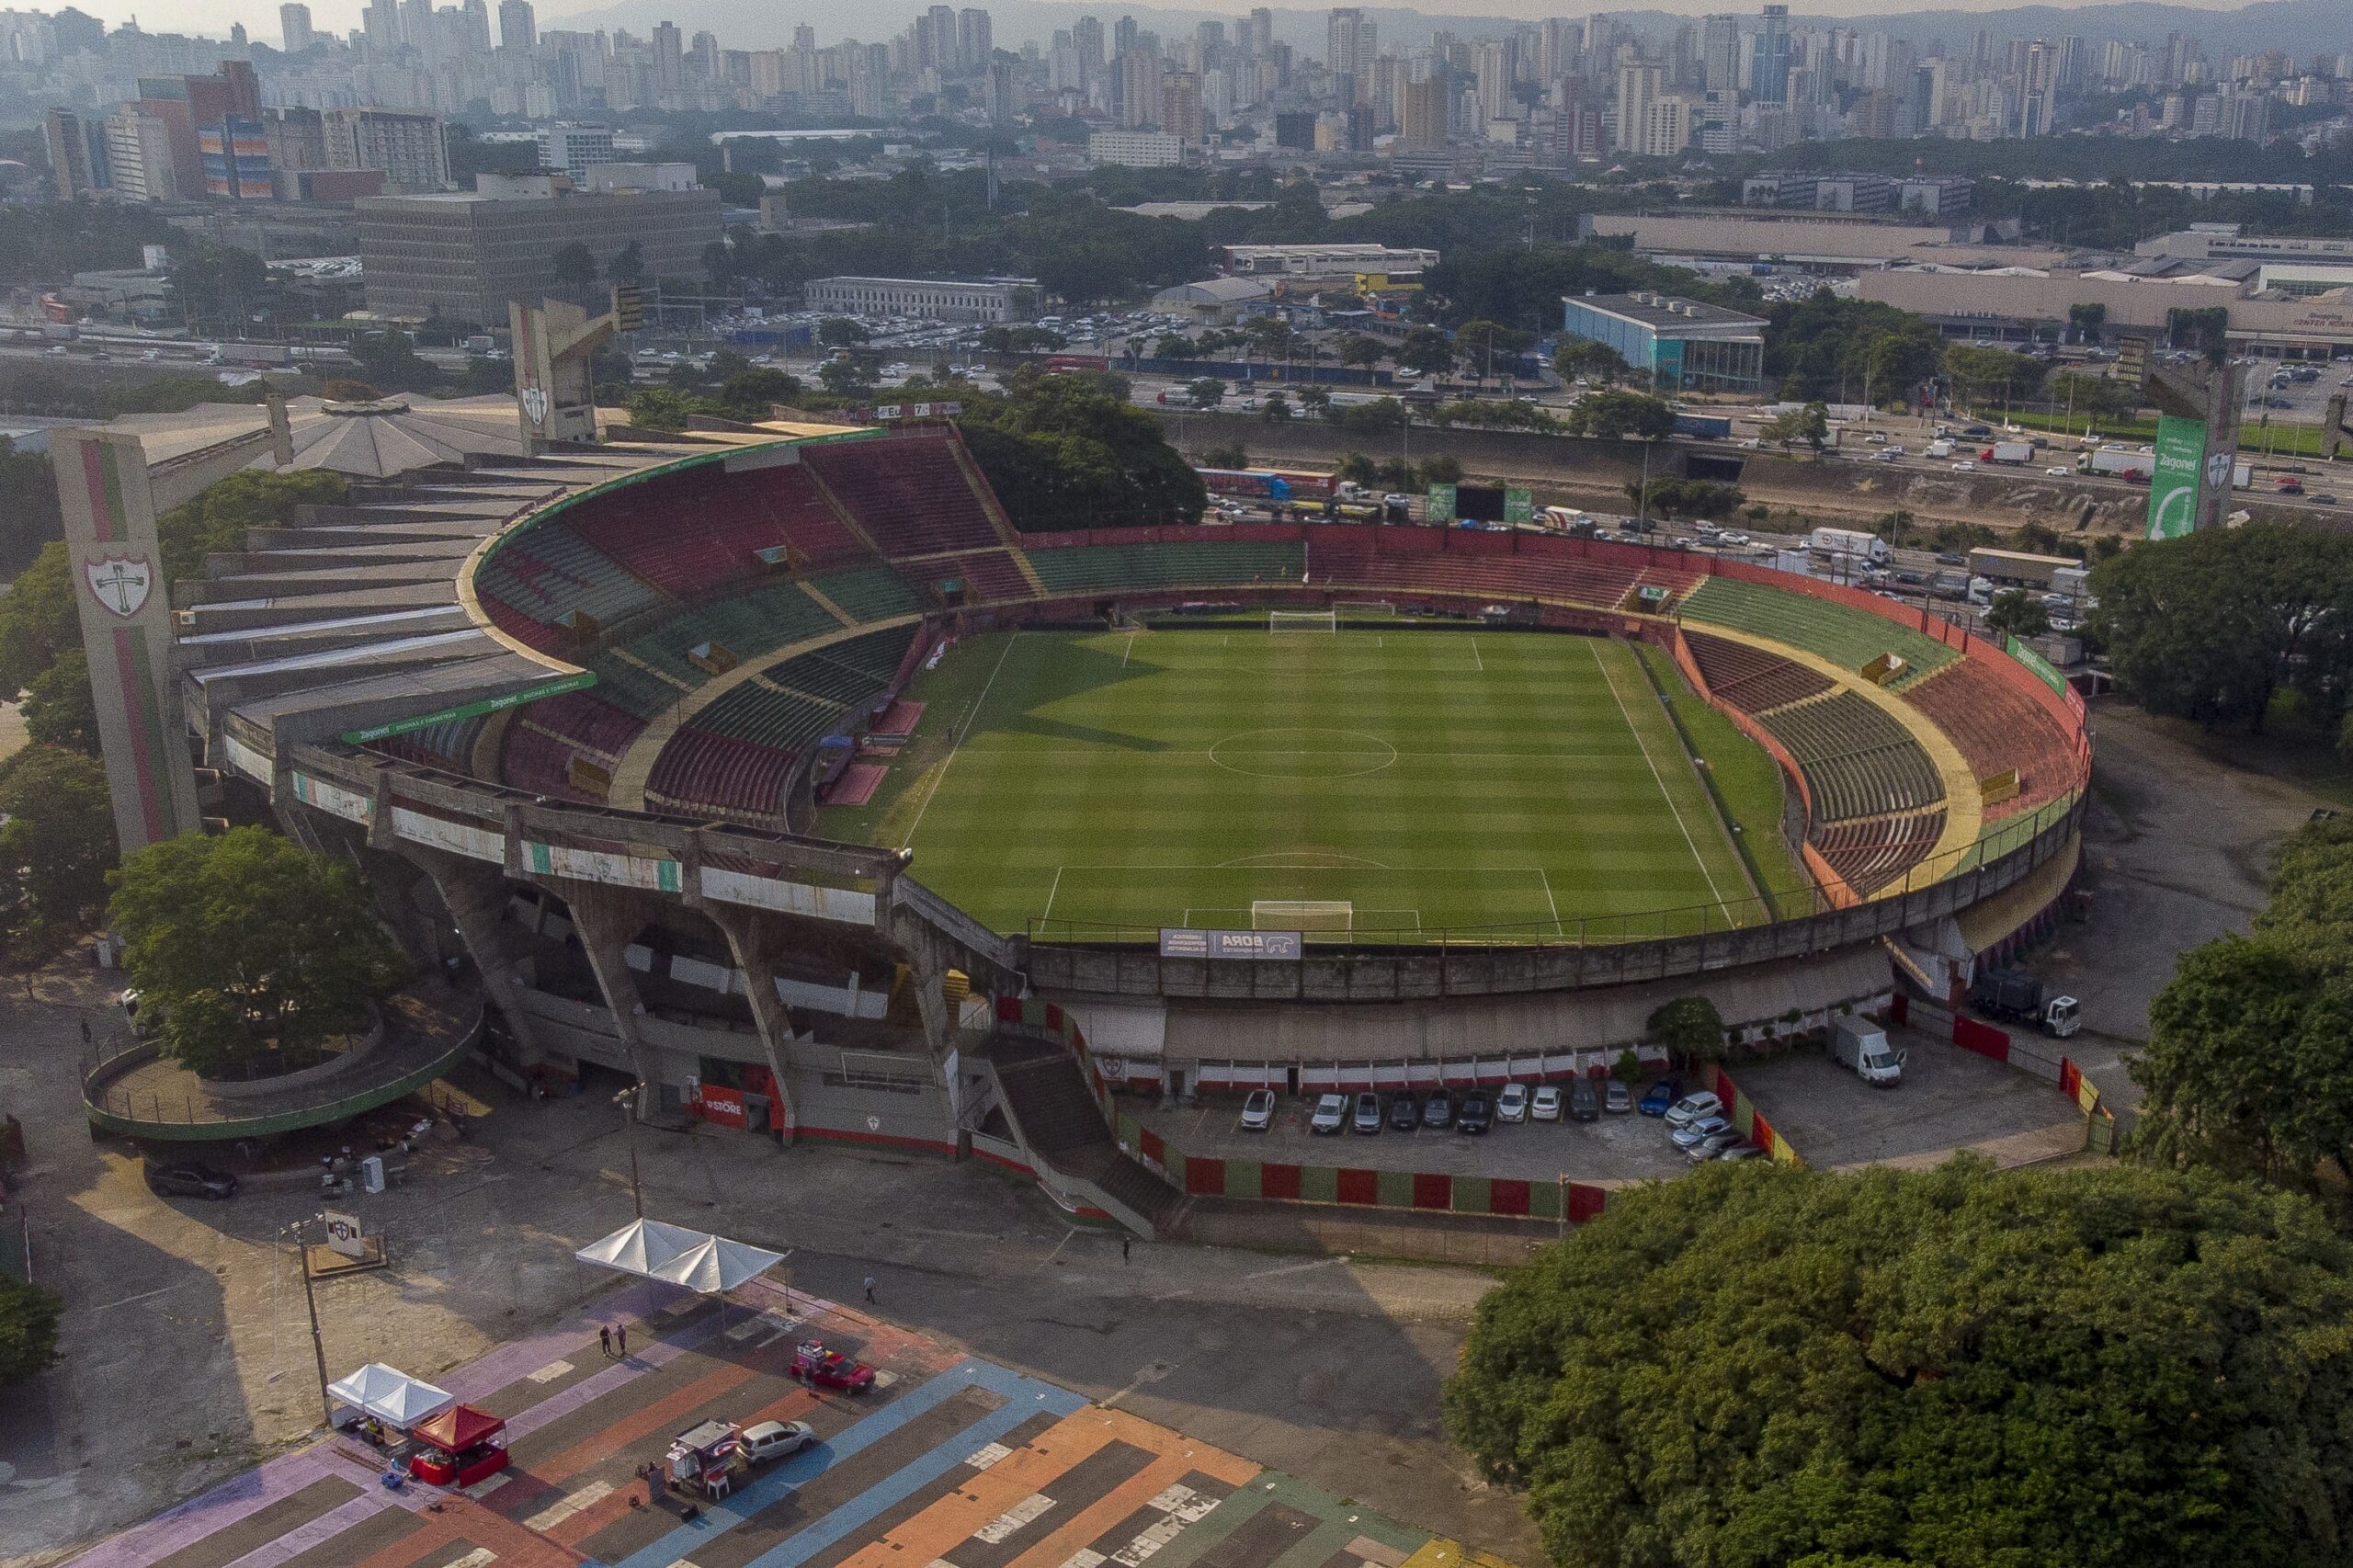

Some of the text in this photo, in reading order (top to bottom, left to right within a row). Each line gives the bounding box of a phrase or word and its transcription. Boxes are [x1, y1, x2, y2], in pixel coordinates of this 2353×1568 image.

[2160, 453, 2197, 470] Zagonel
[490, 695, 517, 709] Zagonel
[359, 725, 390, 739] Zagonel
[713, 1100, 742, 1115] STORE
